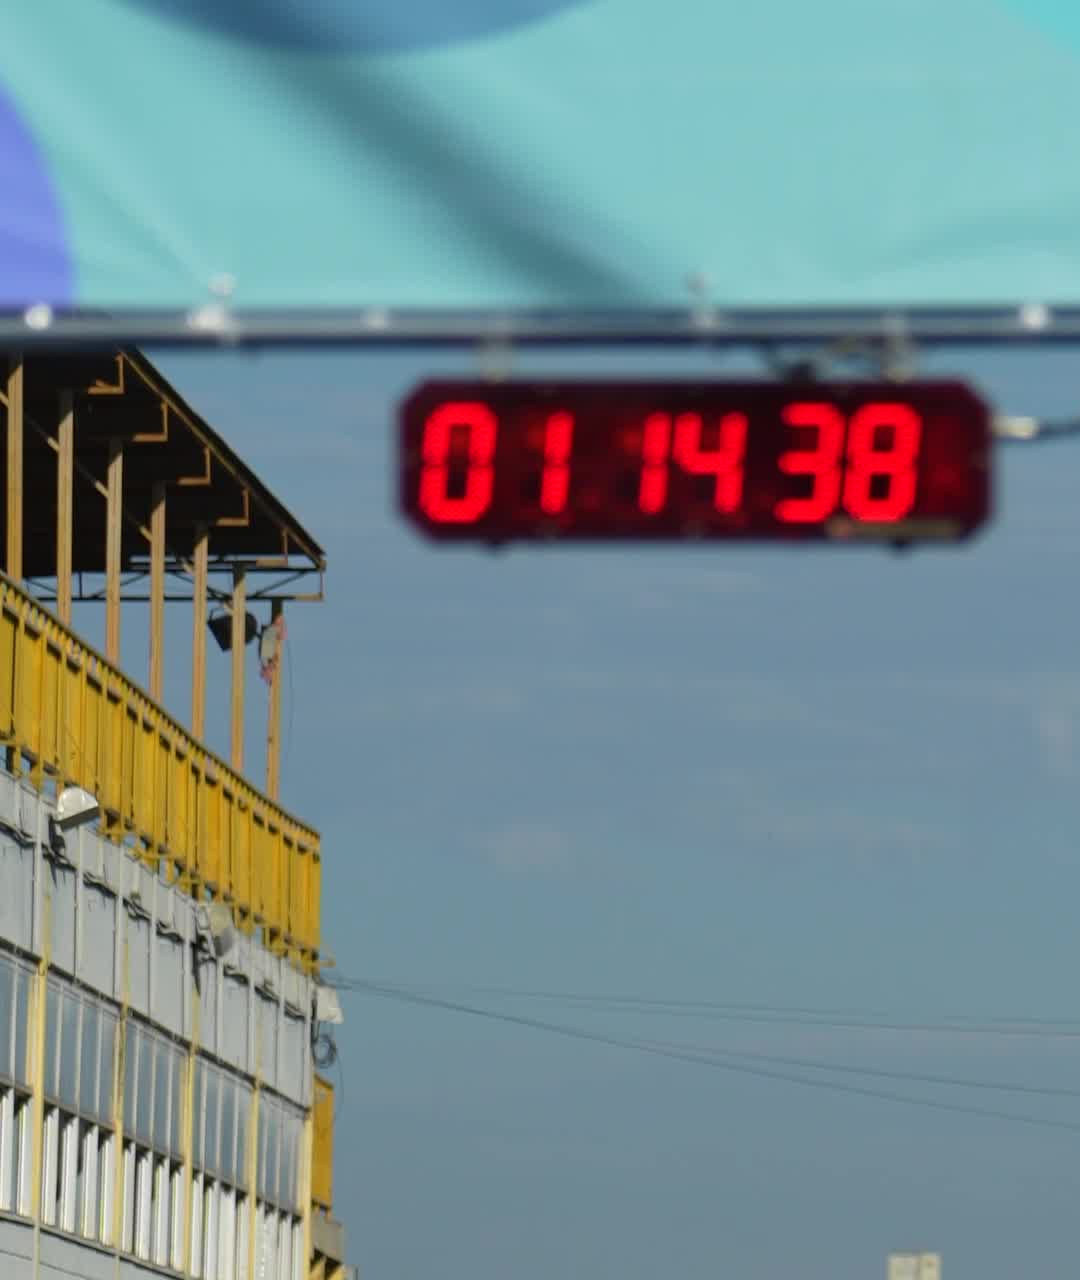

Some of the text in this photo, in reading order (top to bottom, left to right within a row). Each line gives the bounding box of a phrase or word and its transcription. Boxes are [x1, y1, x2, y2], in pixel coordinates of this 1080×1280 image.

[419, 401, 923, 524] 01 14 38
